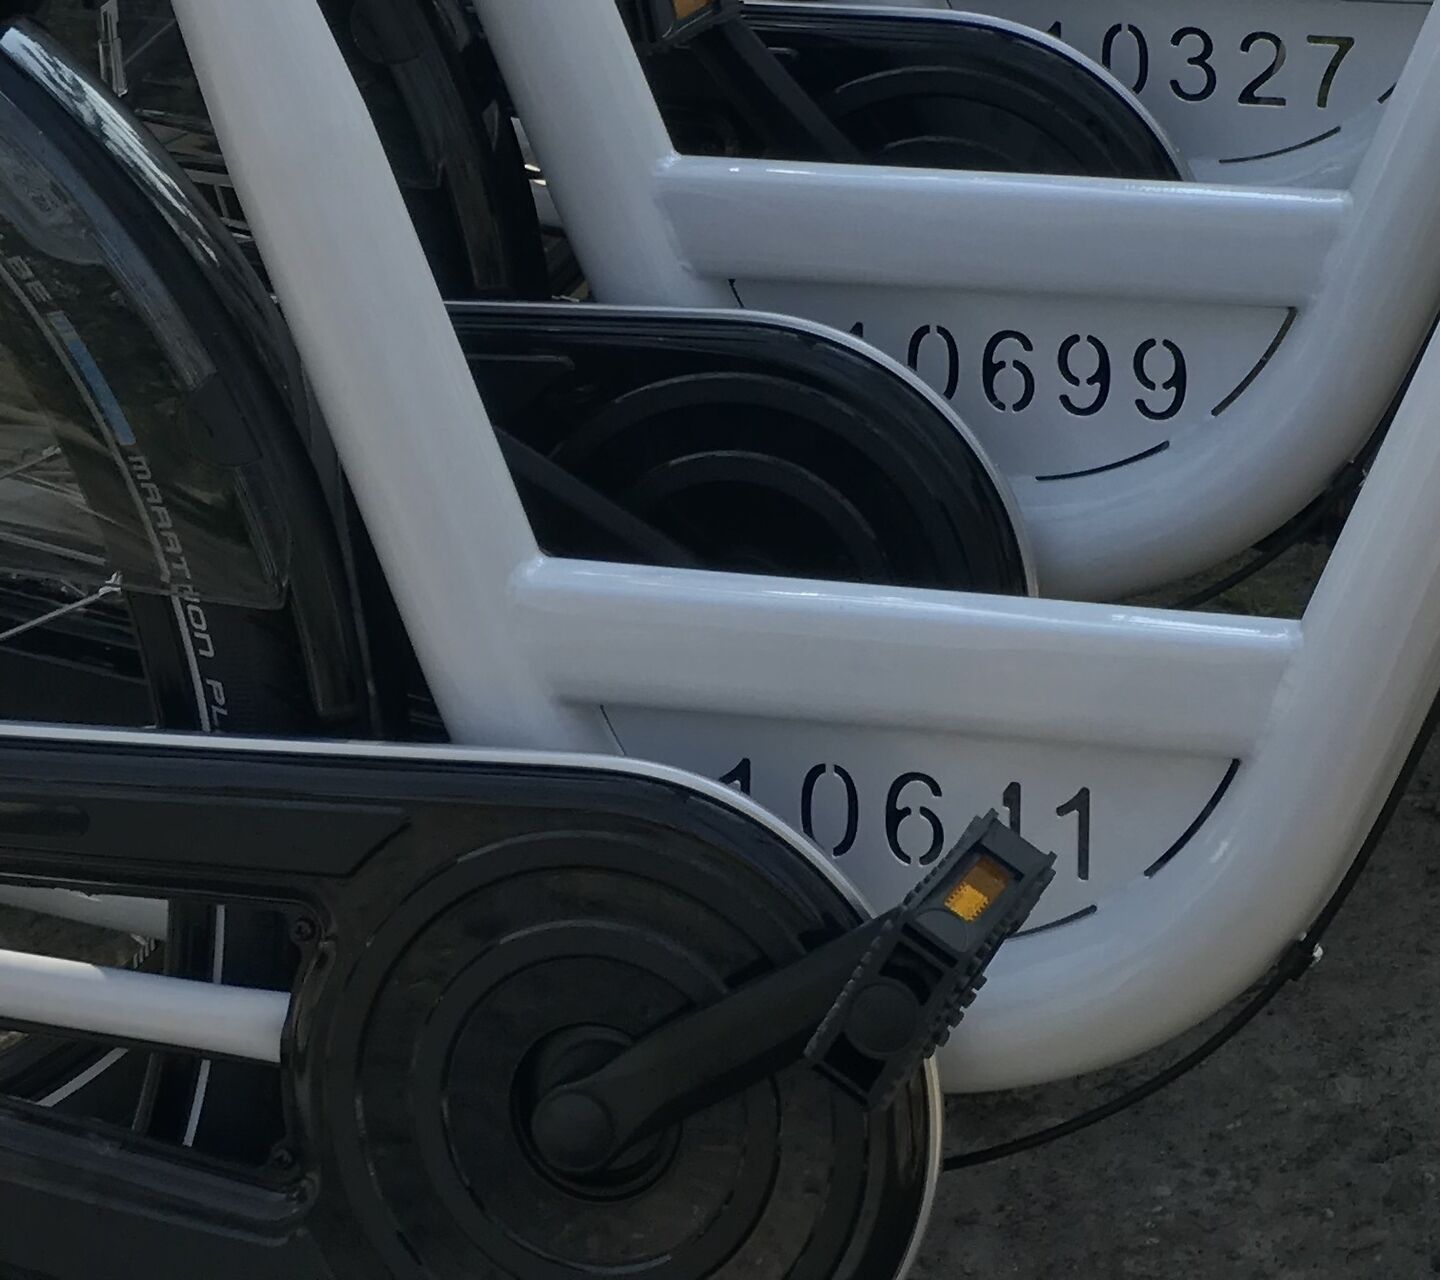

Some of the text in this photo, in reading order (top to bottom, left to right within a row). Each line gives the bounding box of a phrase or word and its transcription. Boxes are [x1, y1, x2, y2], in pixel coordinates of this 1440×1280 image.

[1046, 20, 1356, 108] 0327
[846, 320, 1188, 420] 0699
[128, 455, 216, 660] MARATHON
